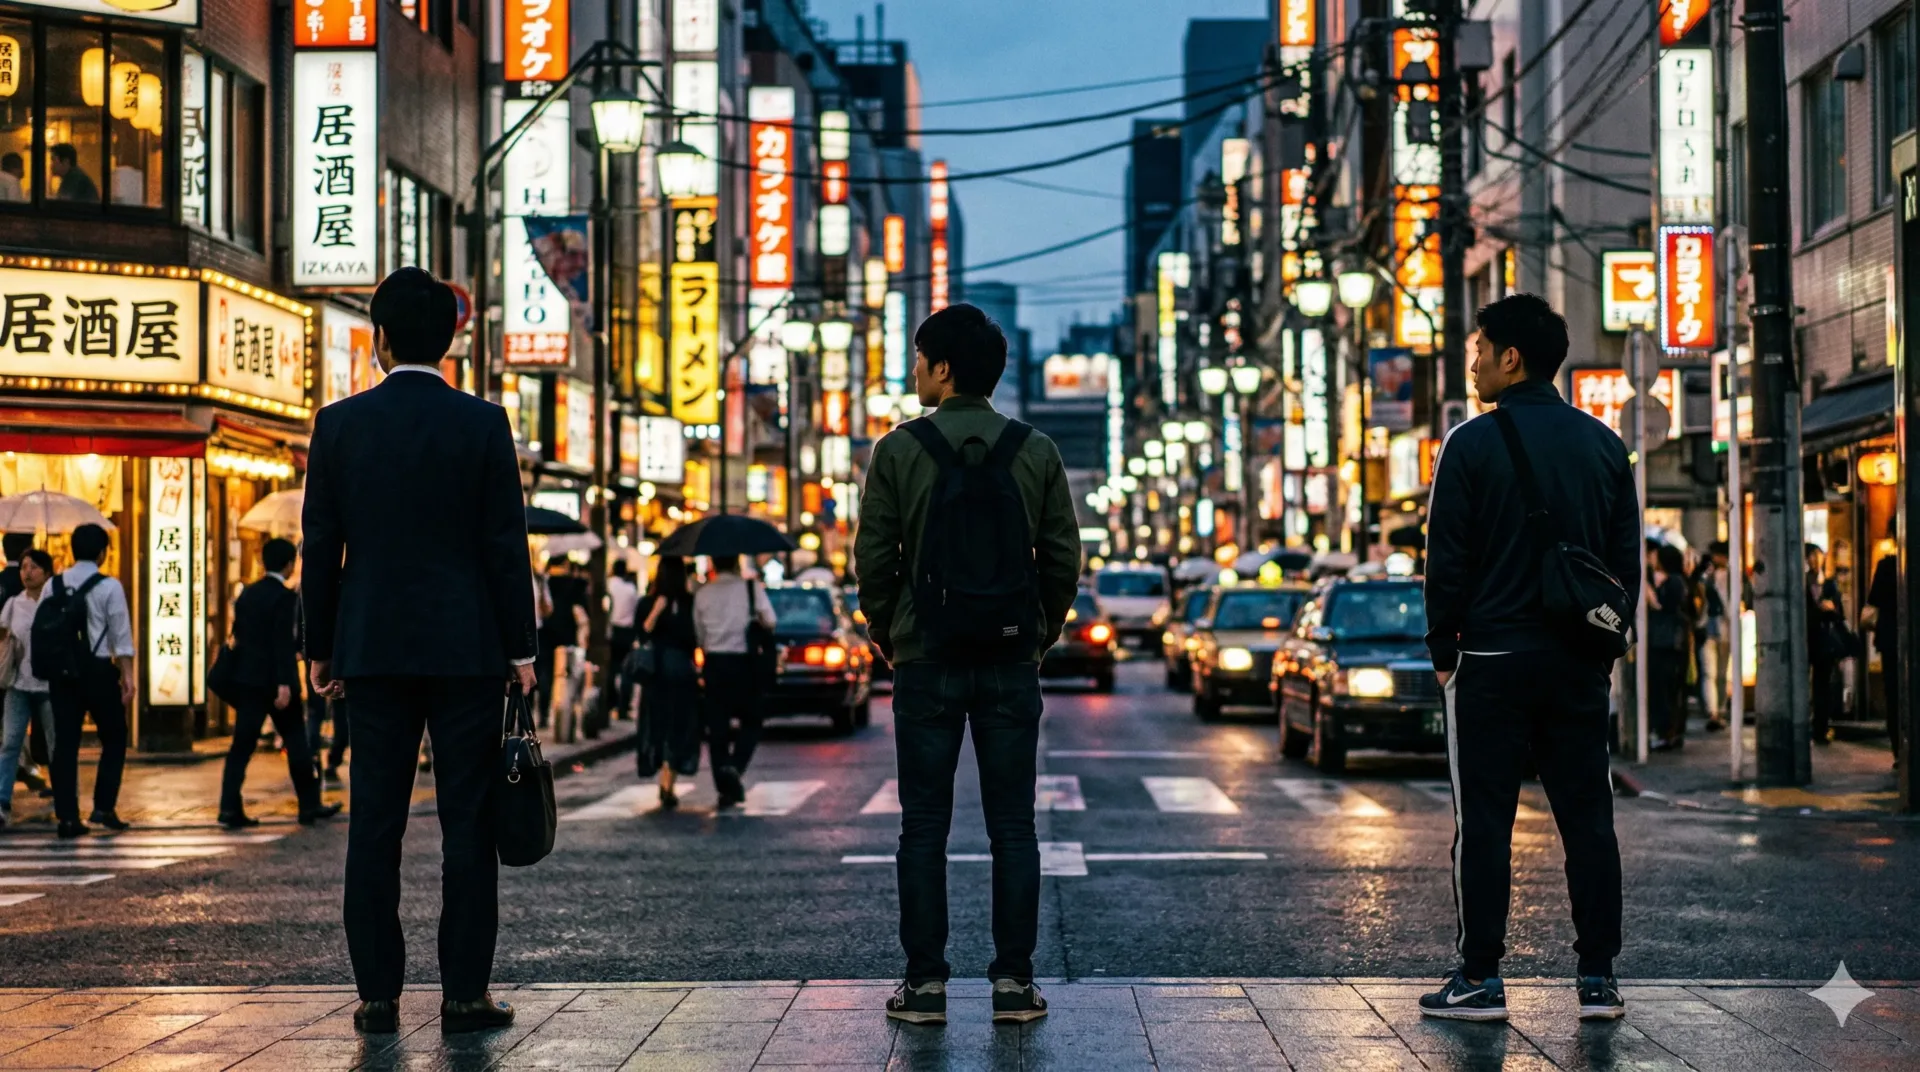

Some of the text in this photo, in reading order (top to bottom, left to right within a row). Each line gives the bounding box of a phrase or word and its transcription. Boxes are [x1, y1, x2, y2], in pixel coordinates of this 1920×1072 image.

[312, 105, 355, 248] 居酒屋
[302, 261, 368, 276] IZKAYA
[0, 292, 181, 360] 居酒屋
[234, 317, 275, 380] 居酒屋
[681, 275, 707, 406] ラーメン
[156, 526, 183, 617] 居酒屋
[1597, 603, 1622, 630] NIKE
